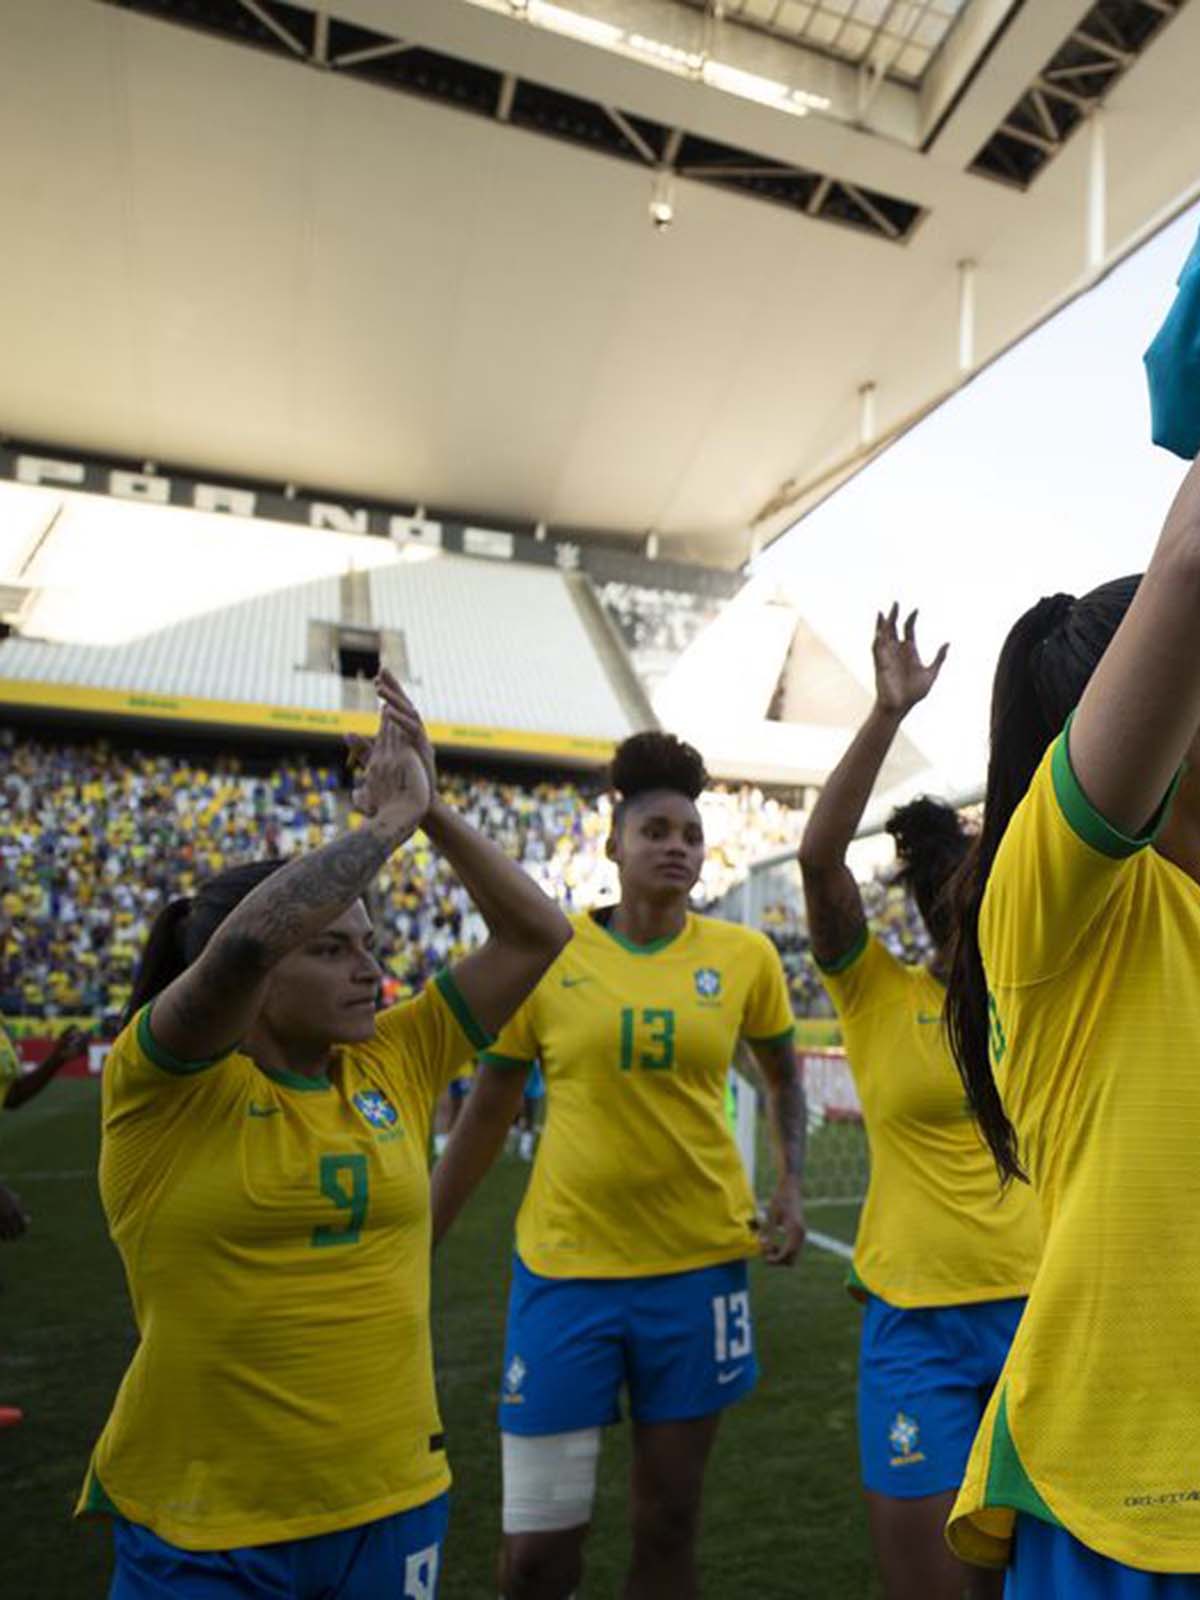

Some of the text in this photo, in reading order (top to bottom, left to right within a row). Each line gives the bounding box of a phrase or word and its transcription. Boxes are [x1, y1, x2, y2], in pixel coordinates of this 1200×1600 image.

[620, 1006, 675, 1071] 13
[310, 1153, 369, 1248] 9
[713, 1291, 752, 1363] 13
